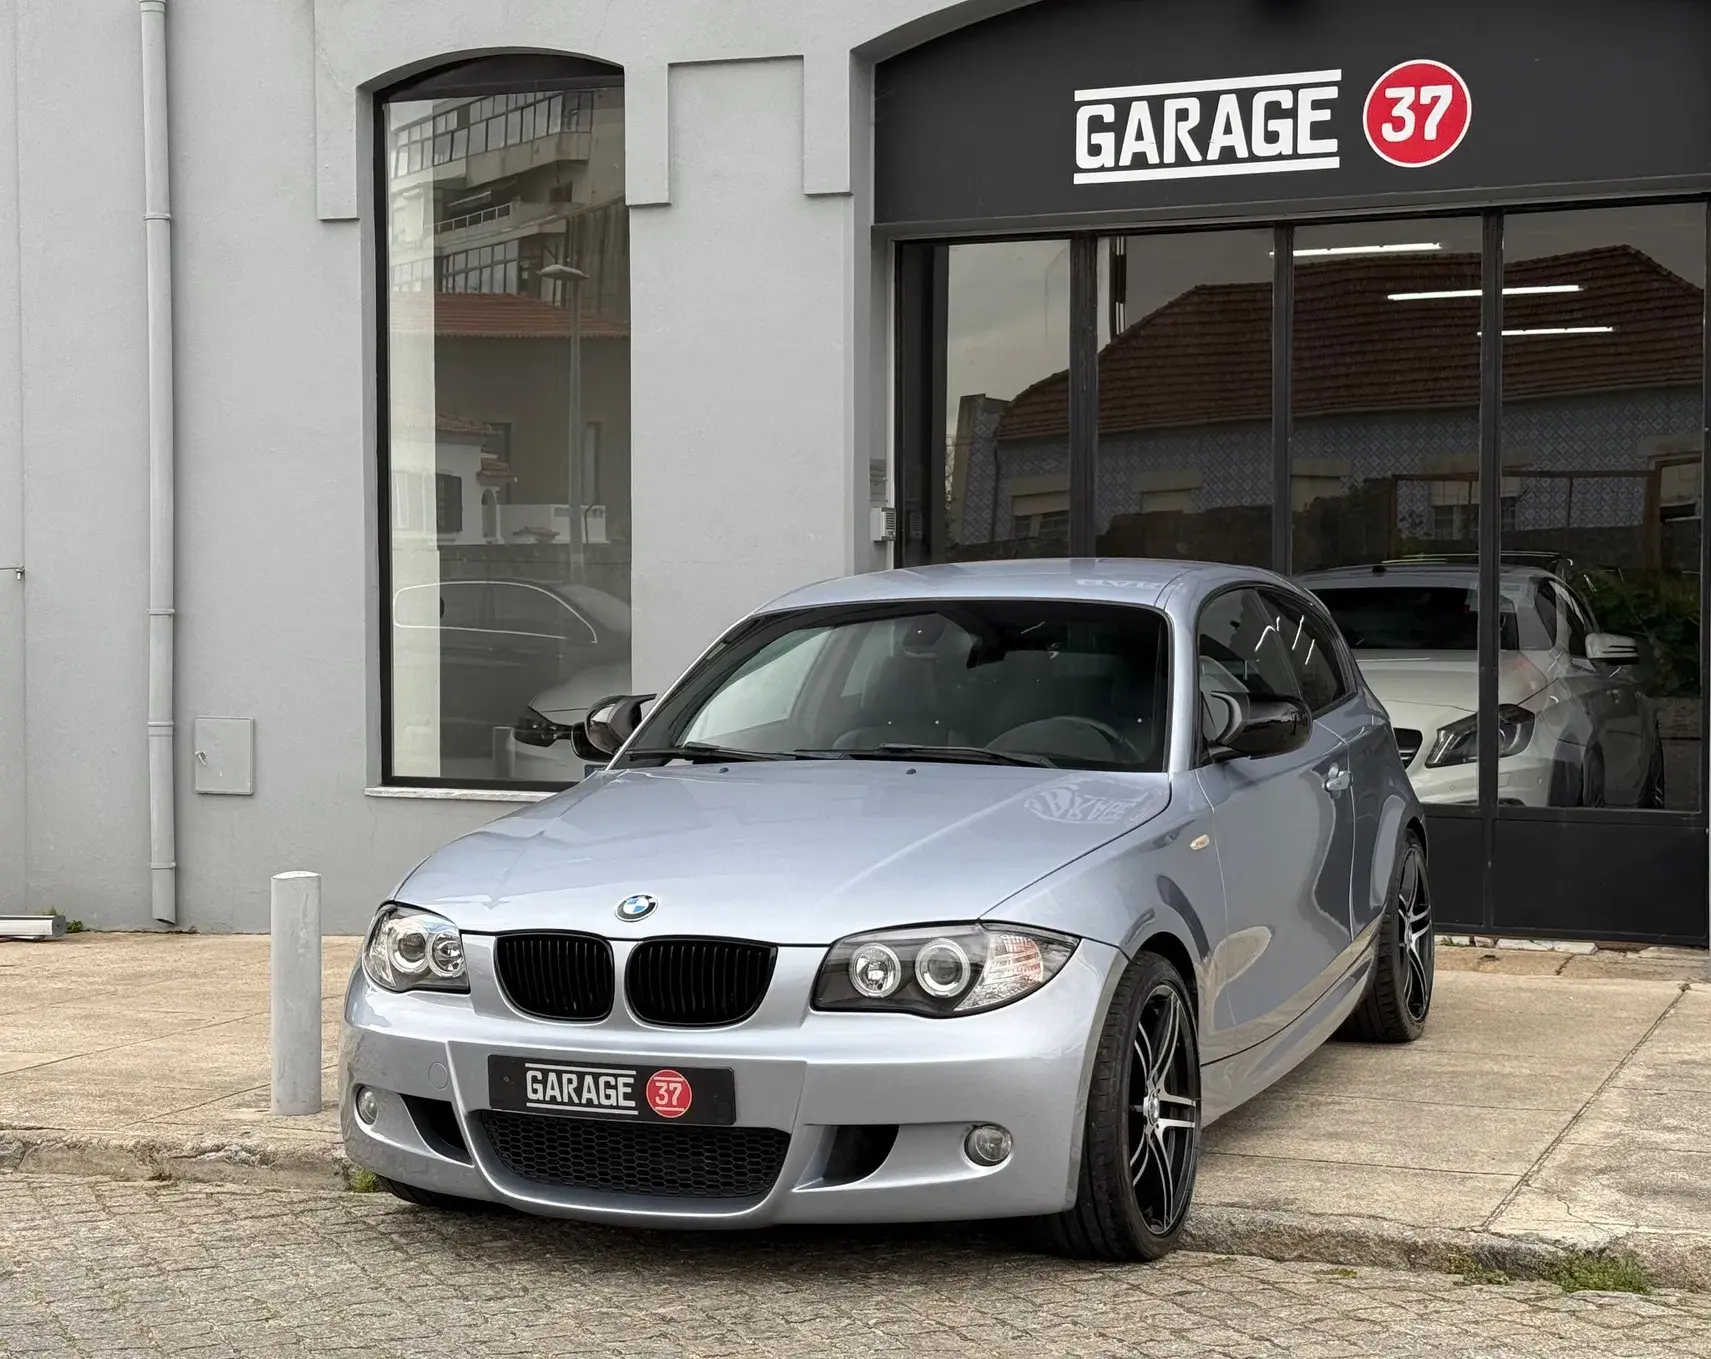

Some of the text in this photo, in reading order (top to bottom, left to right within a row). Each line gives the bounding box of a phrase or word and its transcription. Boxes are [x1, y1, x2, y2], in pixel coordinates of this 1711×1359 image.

[1076, 84, 1453, 169] GARAGE 37
[526, 1070, 683, 1107] GARAGE 37
